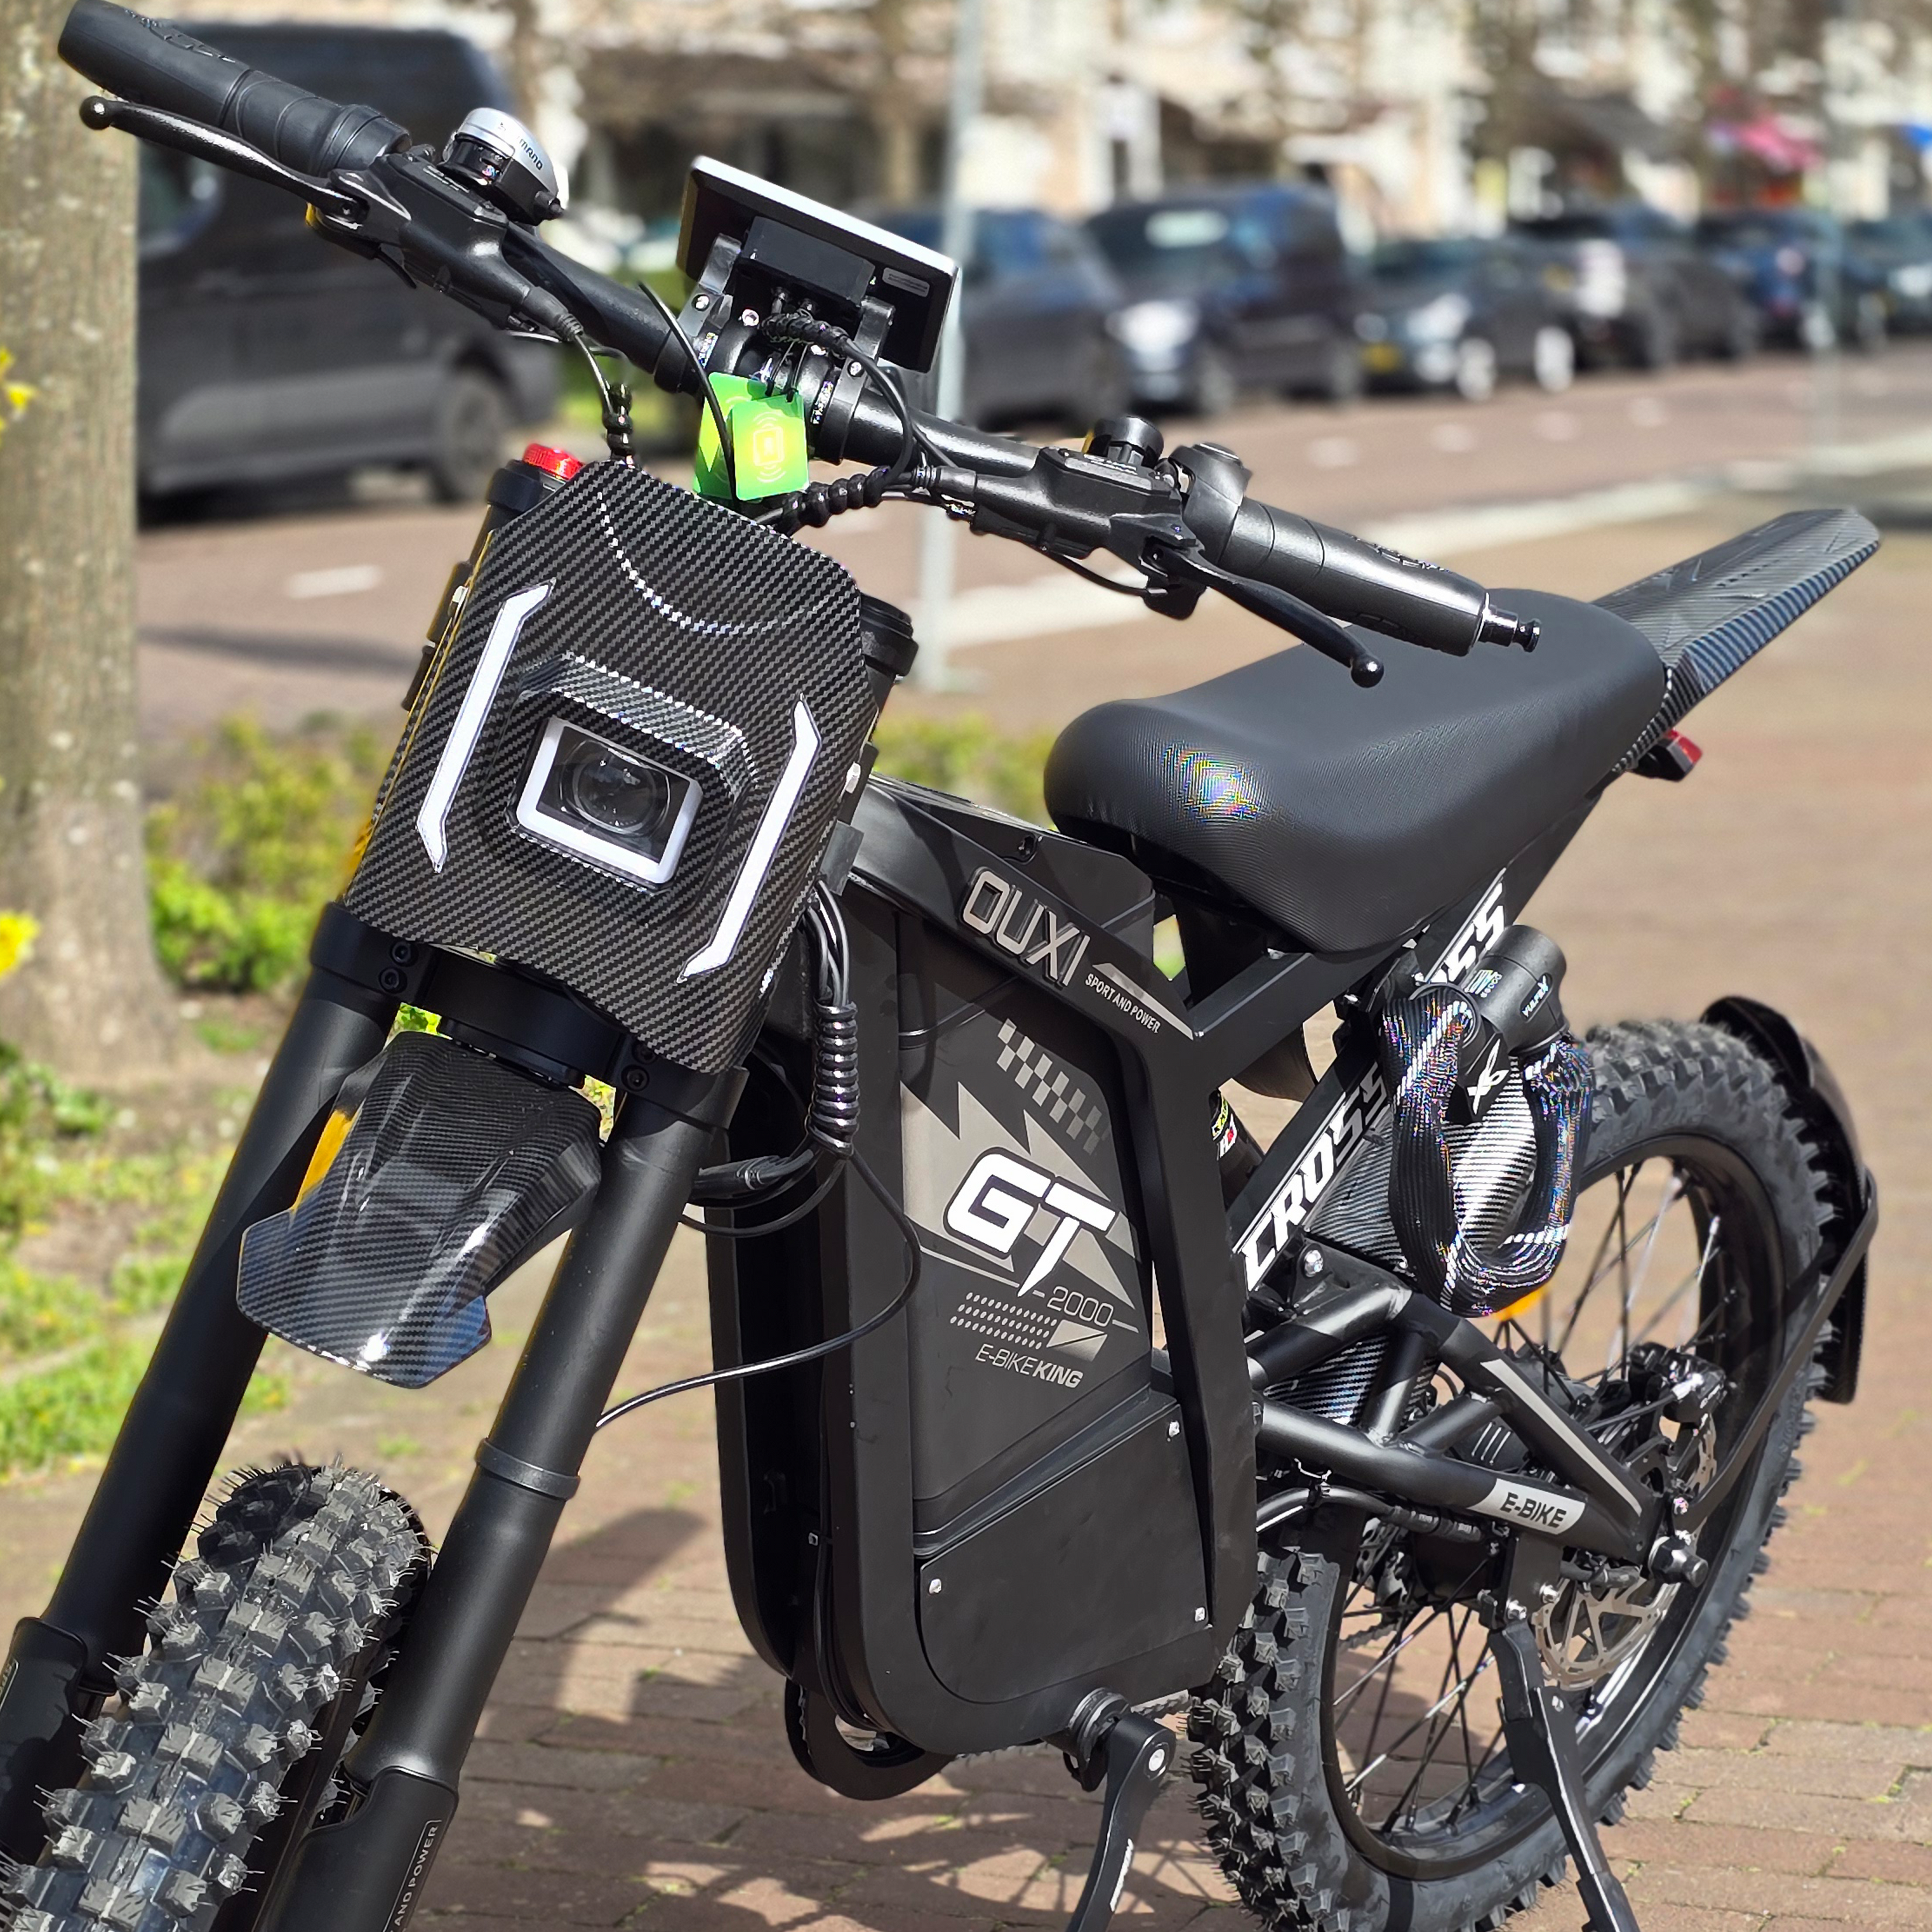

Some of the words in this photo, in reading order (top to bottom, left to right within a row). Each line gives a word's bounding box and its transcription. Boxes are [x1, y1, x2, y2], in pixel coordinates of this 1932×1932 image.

[962, 870, 1090, 987] OUXI
[1085, 974, 1115, 1000] SPORT
[1112, 993, 1132, 1012] AND
[1130, 1006, 1161, 1033] POWER
[946, 1153, 1116, 1297] GT
[1242, 1062, 1388, 1292] CROSS
[1047, 1286, 1114, 1327] 2000
[1499, 1492, 1567, 1528] E-BIKE
[394, 1891, 412, 1926] AND
[408, 1826, 438, 1887] POWER
